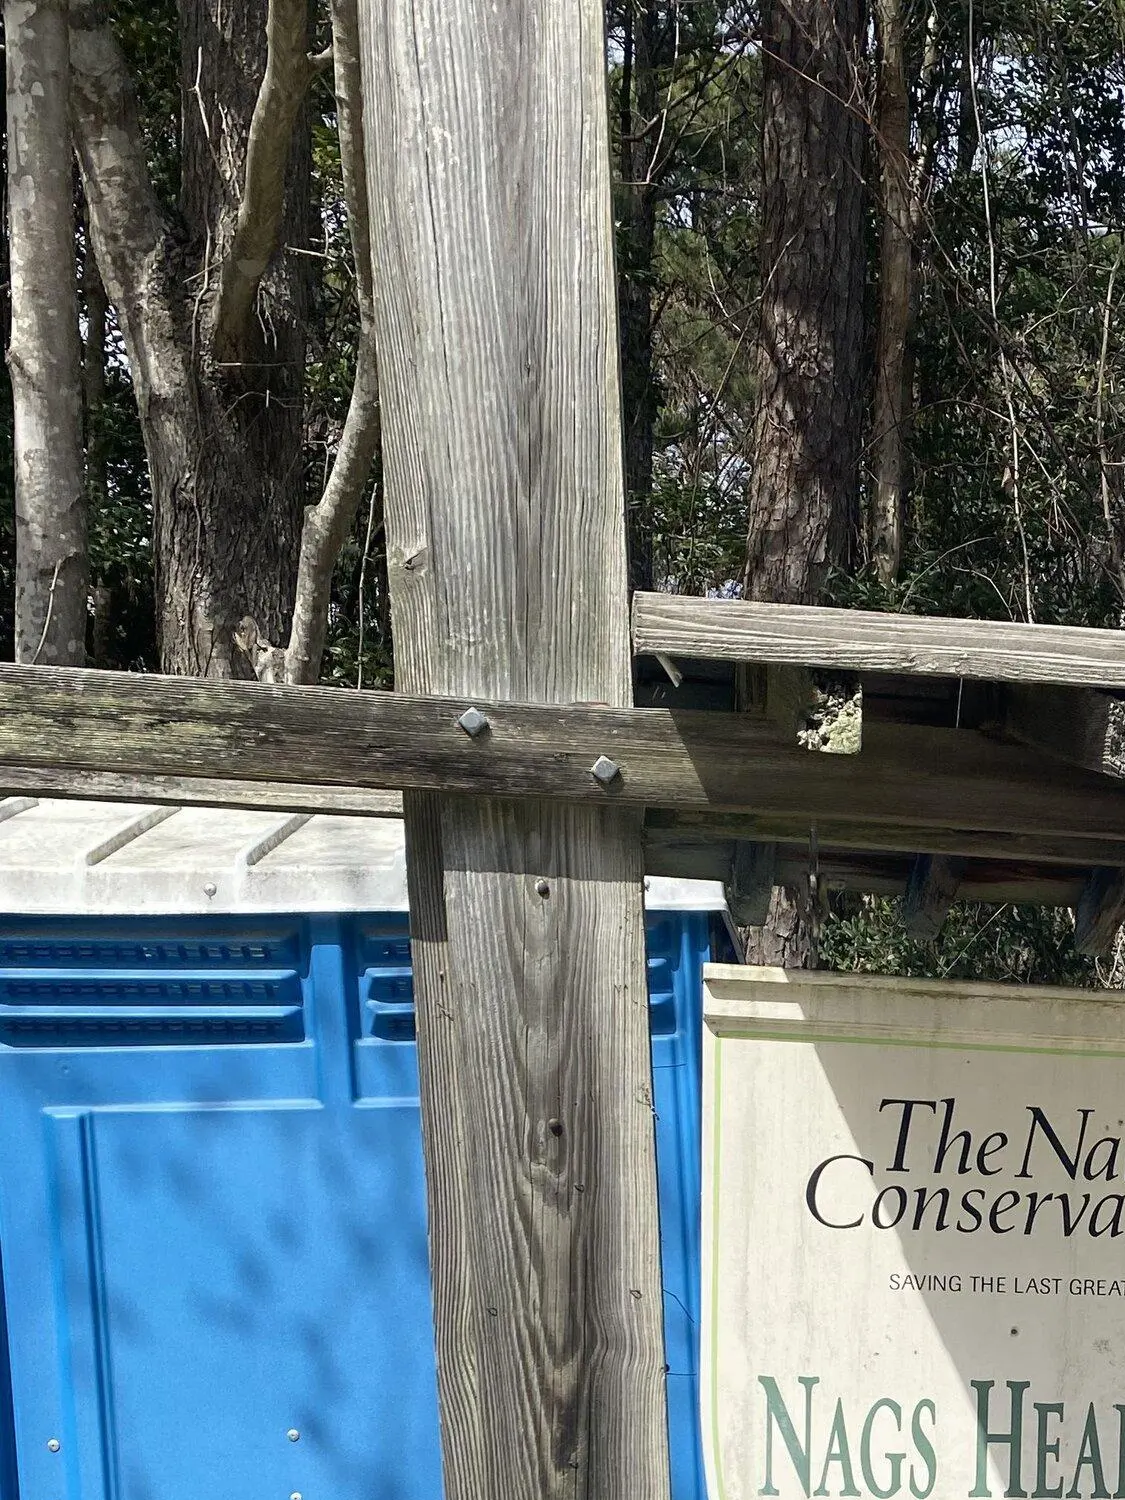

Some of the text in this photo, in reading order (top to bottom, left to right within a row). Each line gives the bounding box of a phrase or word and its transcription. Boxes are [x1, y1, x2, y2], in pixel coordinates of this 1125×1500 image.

[879, 1097, 1008, 1177] The
[888, 1274, 963, 1293] SAVING
[968, 1276, 1006, 1294] THE
[1014, 1277, 1062, 1296] LAST
[757, 1375, 937, 1499] NAGS
